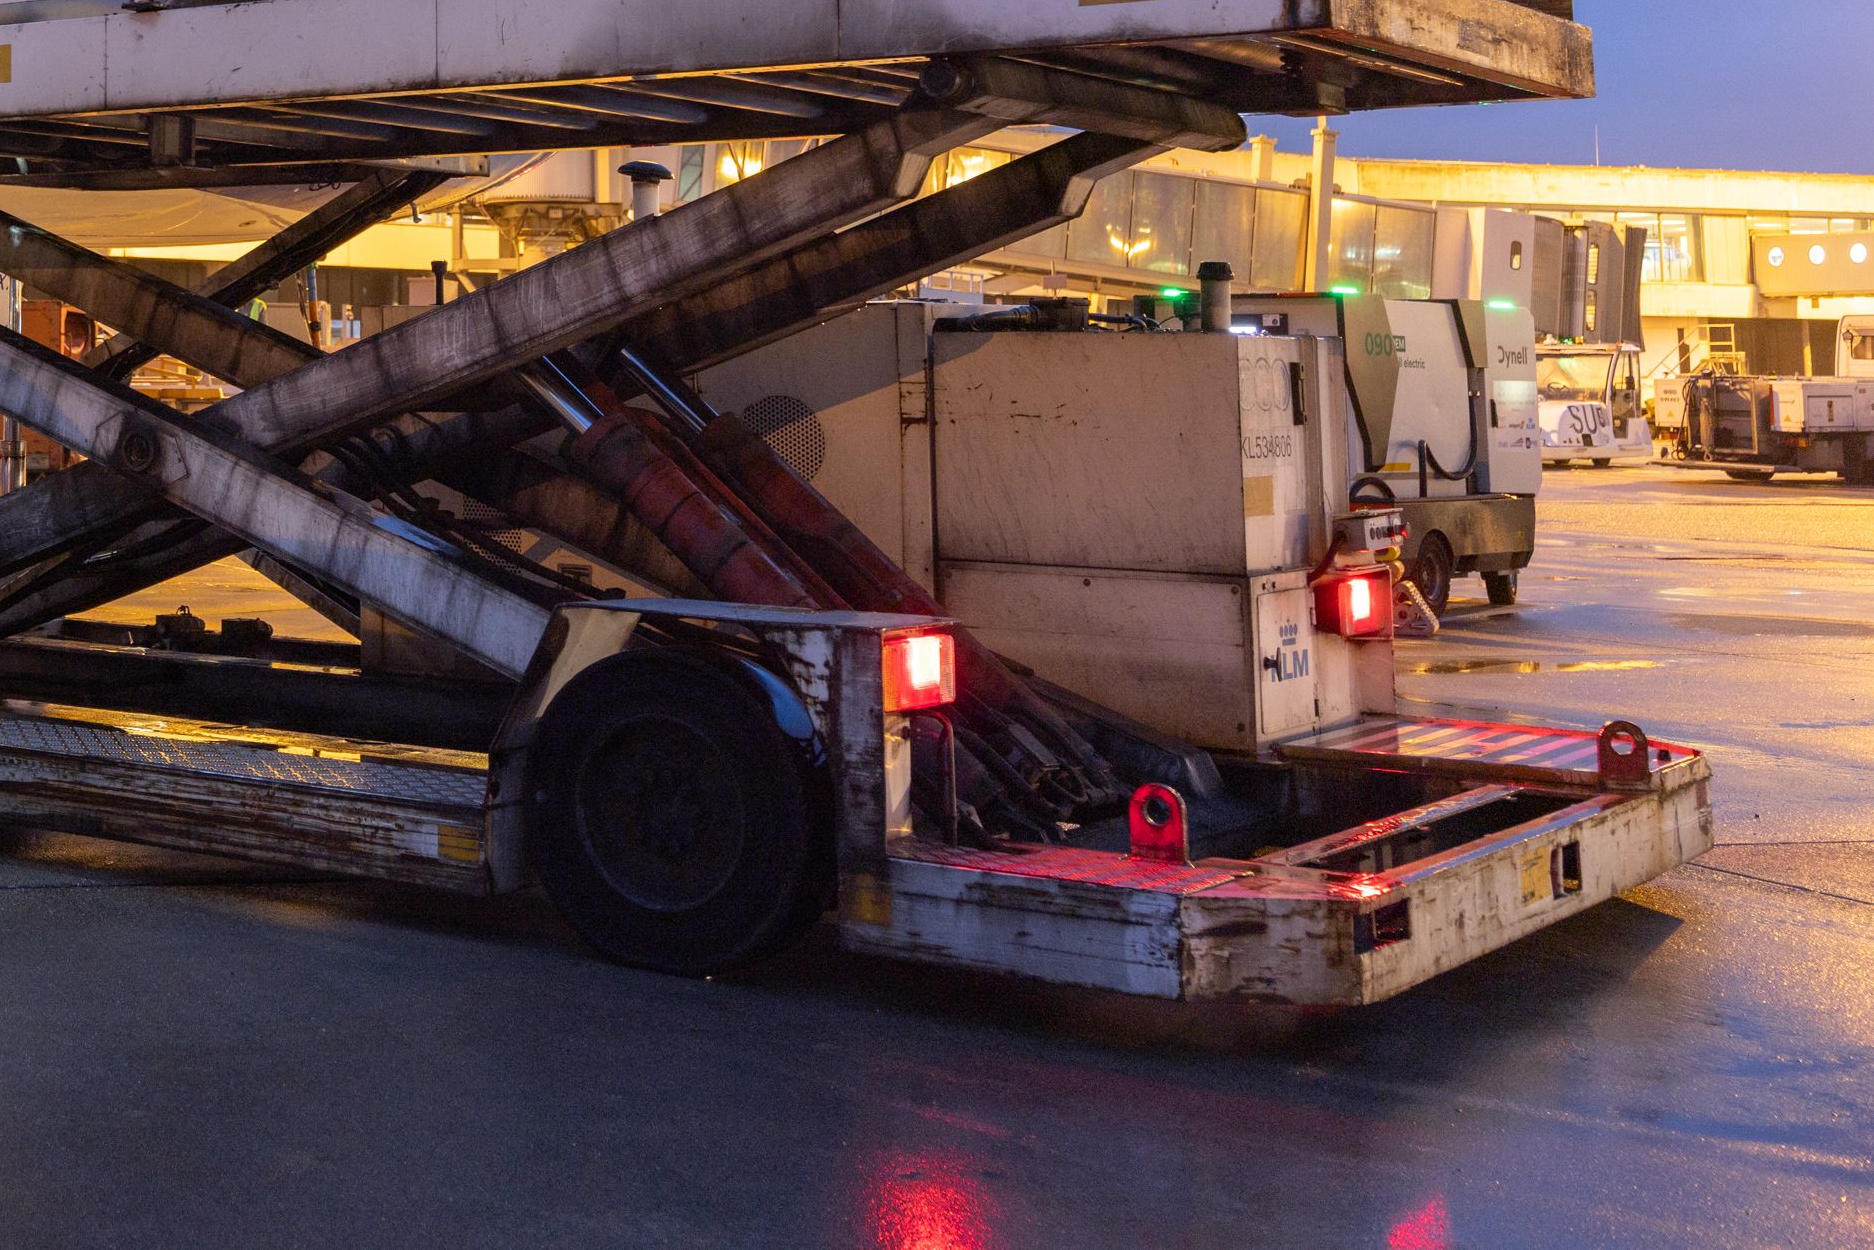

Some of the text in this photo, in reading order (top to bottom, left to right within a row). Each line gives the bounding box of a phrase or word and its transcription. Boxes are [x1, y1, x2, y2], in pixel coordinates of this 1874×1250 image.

[1365, 333, 1392, 356] 090
[1403, 358, 1426, 369] electric
[1241, 435, 1292, 459] KL534806
